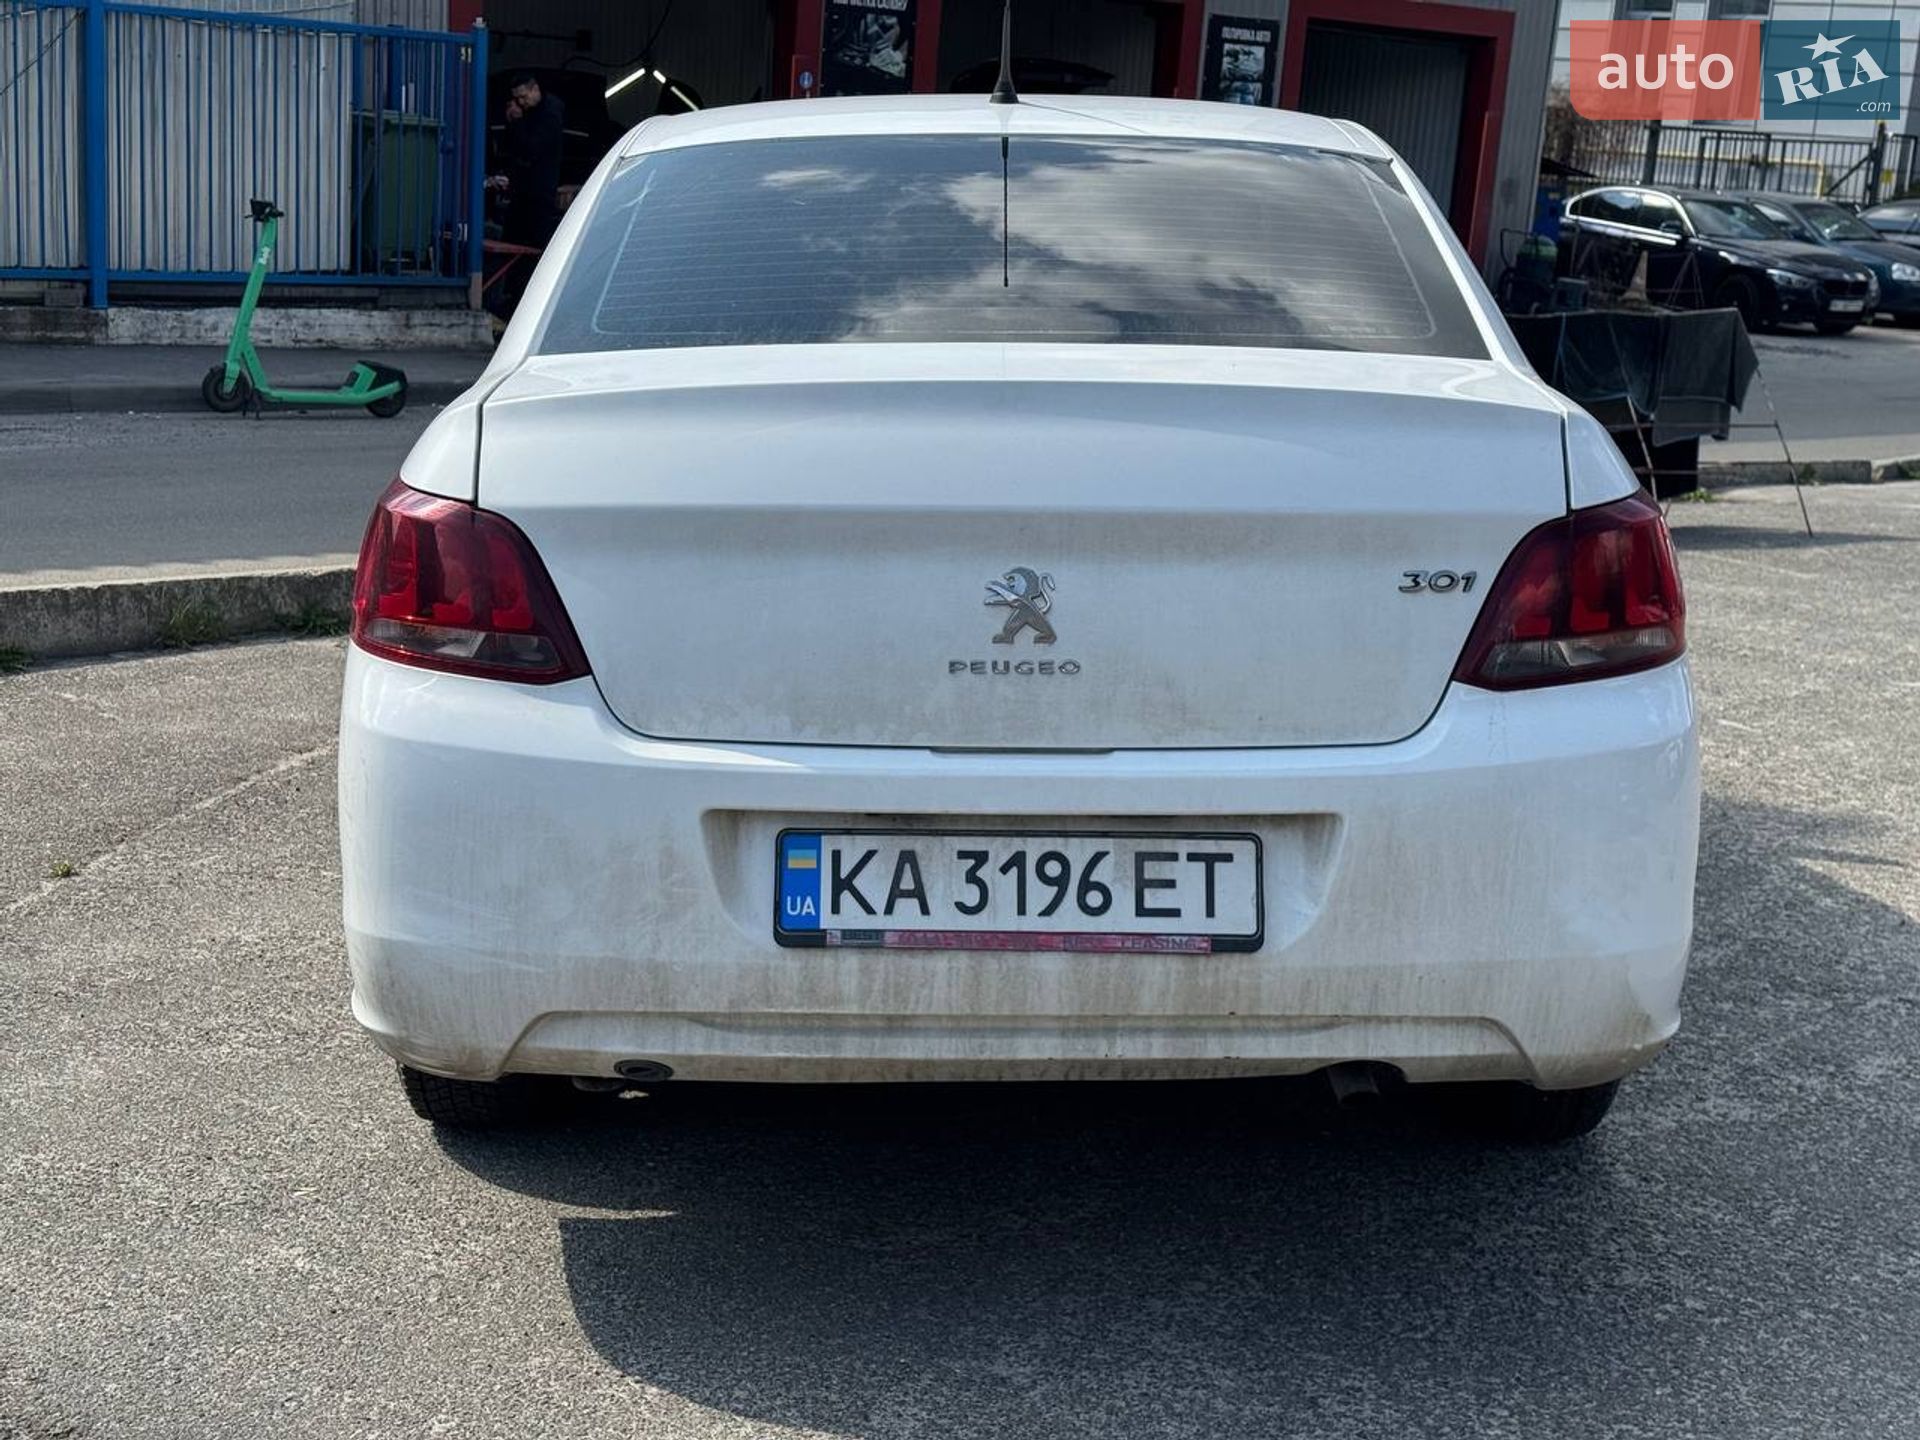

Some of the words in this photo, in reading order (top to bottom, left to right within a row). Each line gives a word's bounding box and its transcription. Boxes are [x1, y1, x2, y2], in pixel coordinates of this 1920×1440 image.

[1398, 569, 1477, 593] 301
[948, 659, 1080, 675] PEUGEO
[831, 849, 931, 916] KA
[954, 850, 1113, 917] 3196
[1134, 851, 1233, 918] ET
[787, 895, 816, 916] UA
